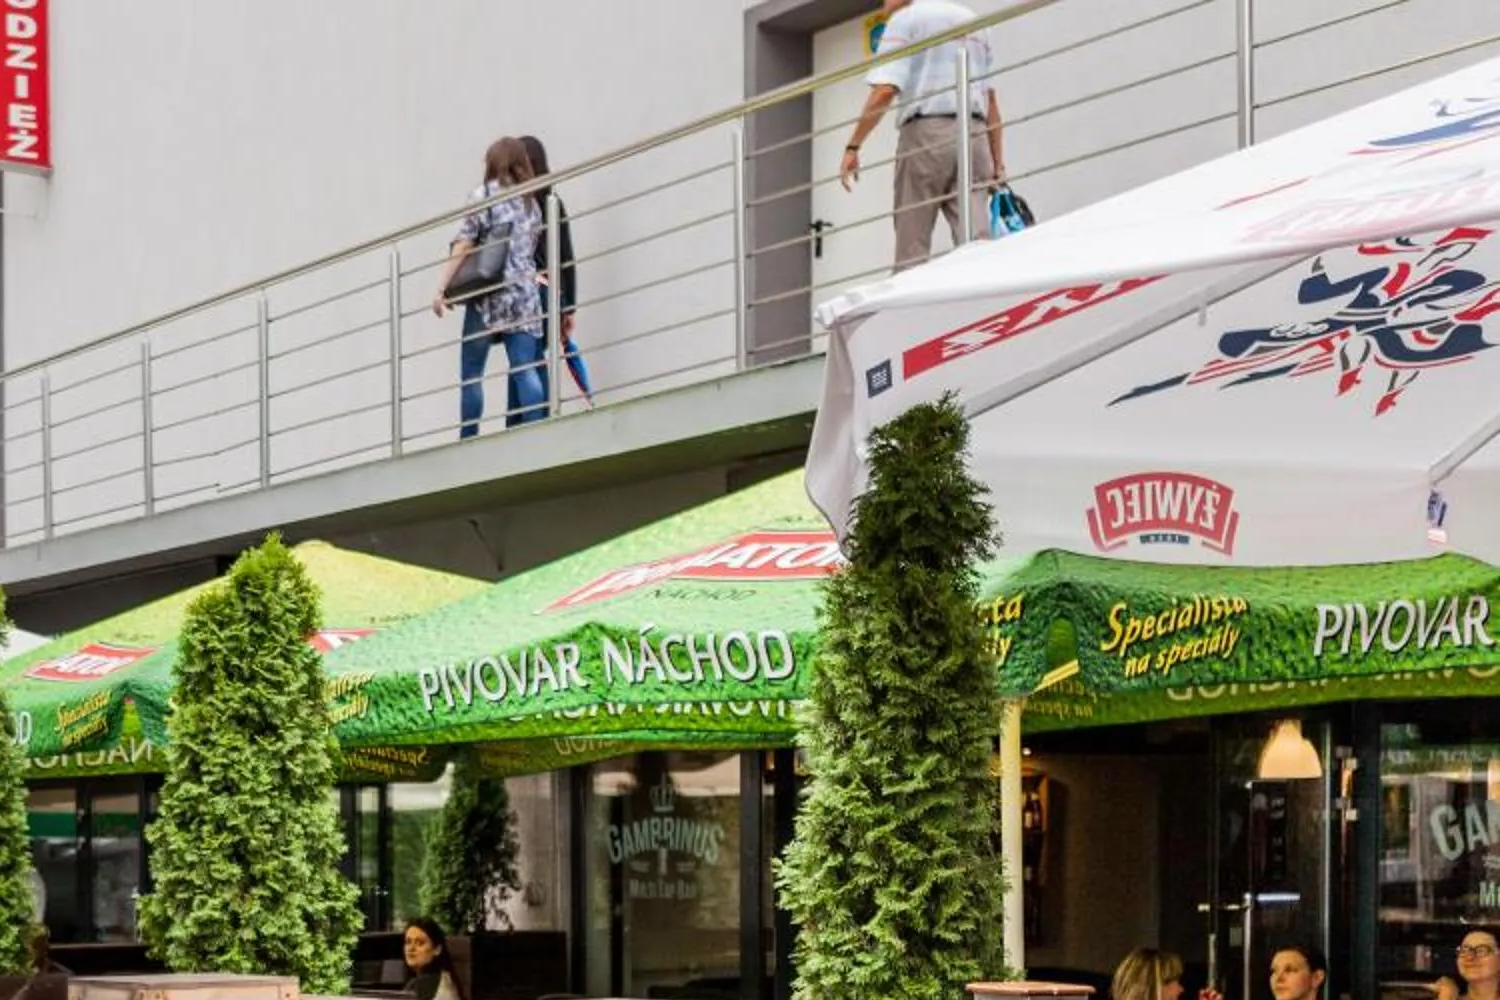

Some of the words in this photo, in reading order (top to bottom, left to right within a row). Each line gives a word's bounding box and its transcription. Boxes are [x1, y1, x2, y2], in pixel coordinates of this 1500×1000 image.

[1101, 592, 1248, 657] Specialista
[1313, 594, 1495, 657] PIVOVAR
[419, 641, 590, 712] PIVOVAR
[604, 623, 796, 685] NÁCHOD
[1124, 656, 1149, 677] na
[607, 817, 725, 866] GAMBRINUS
